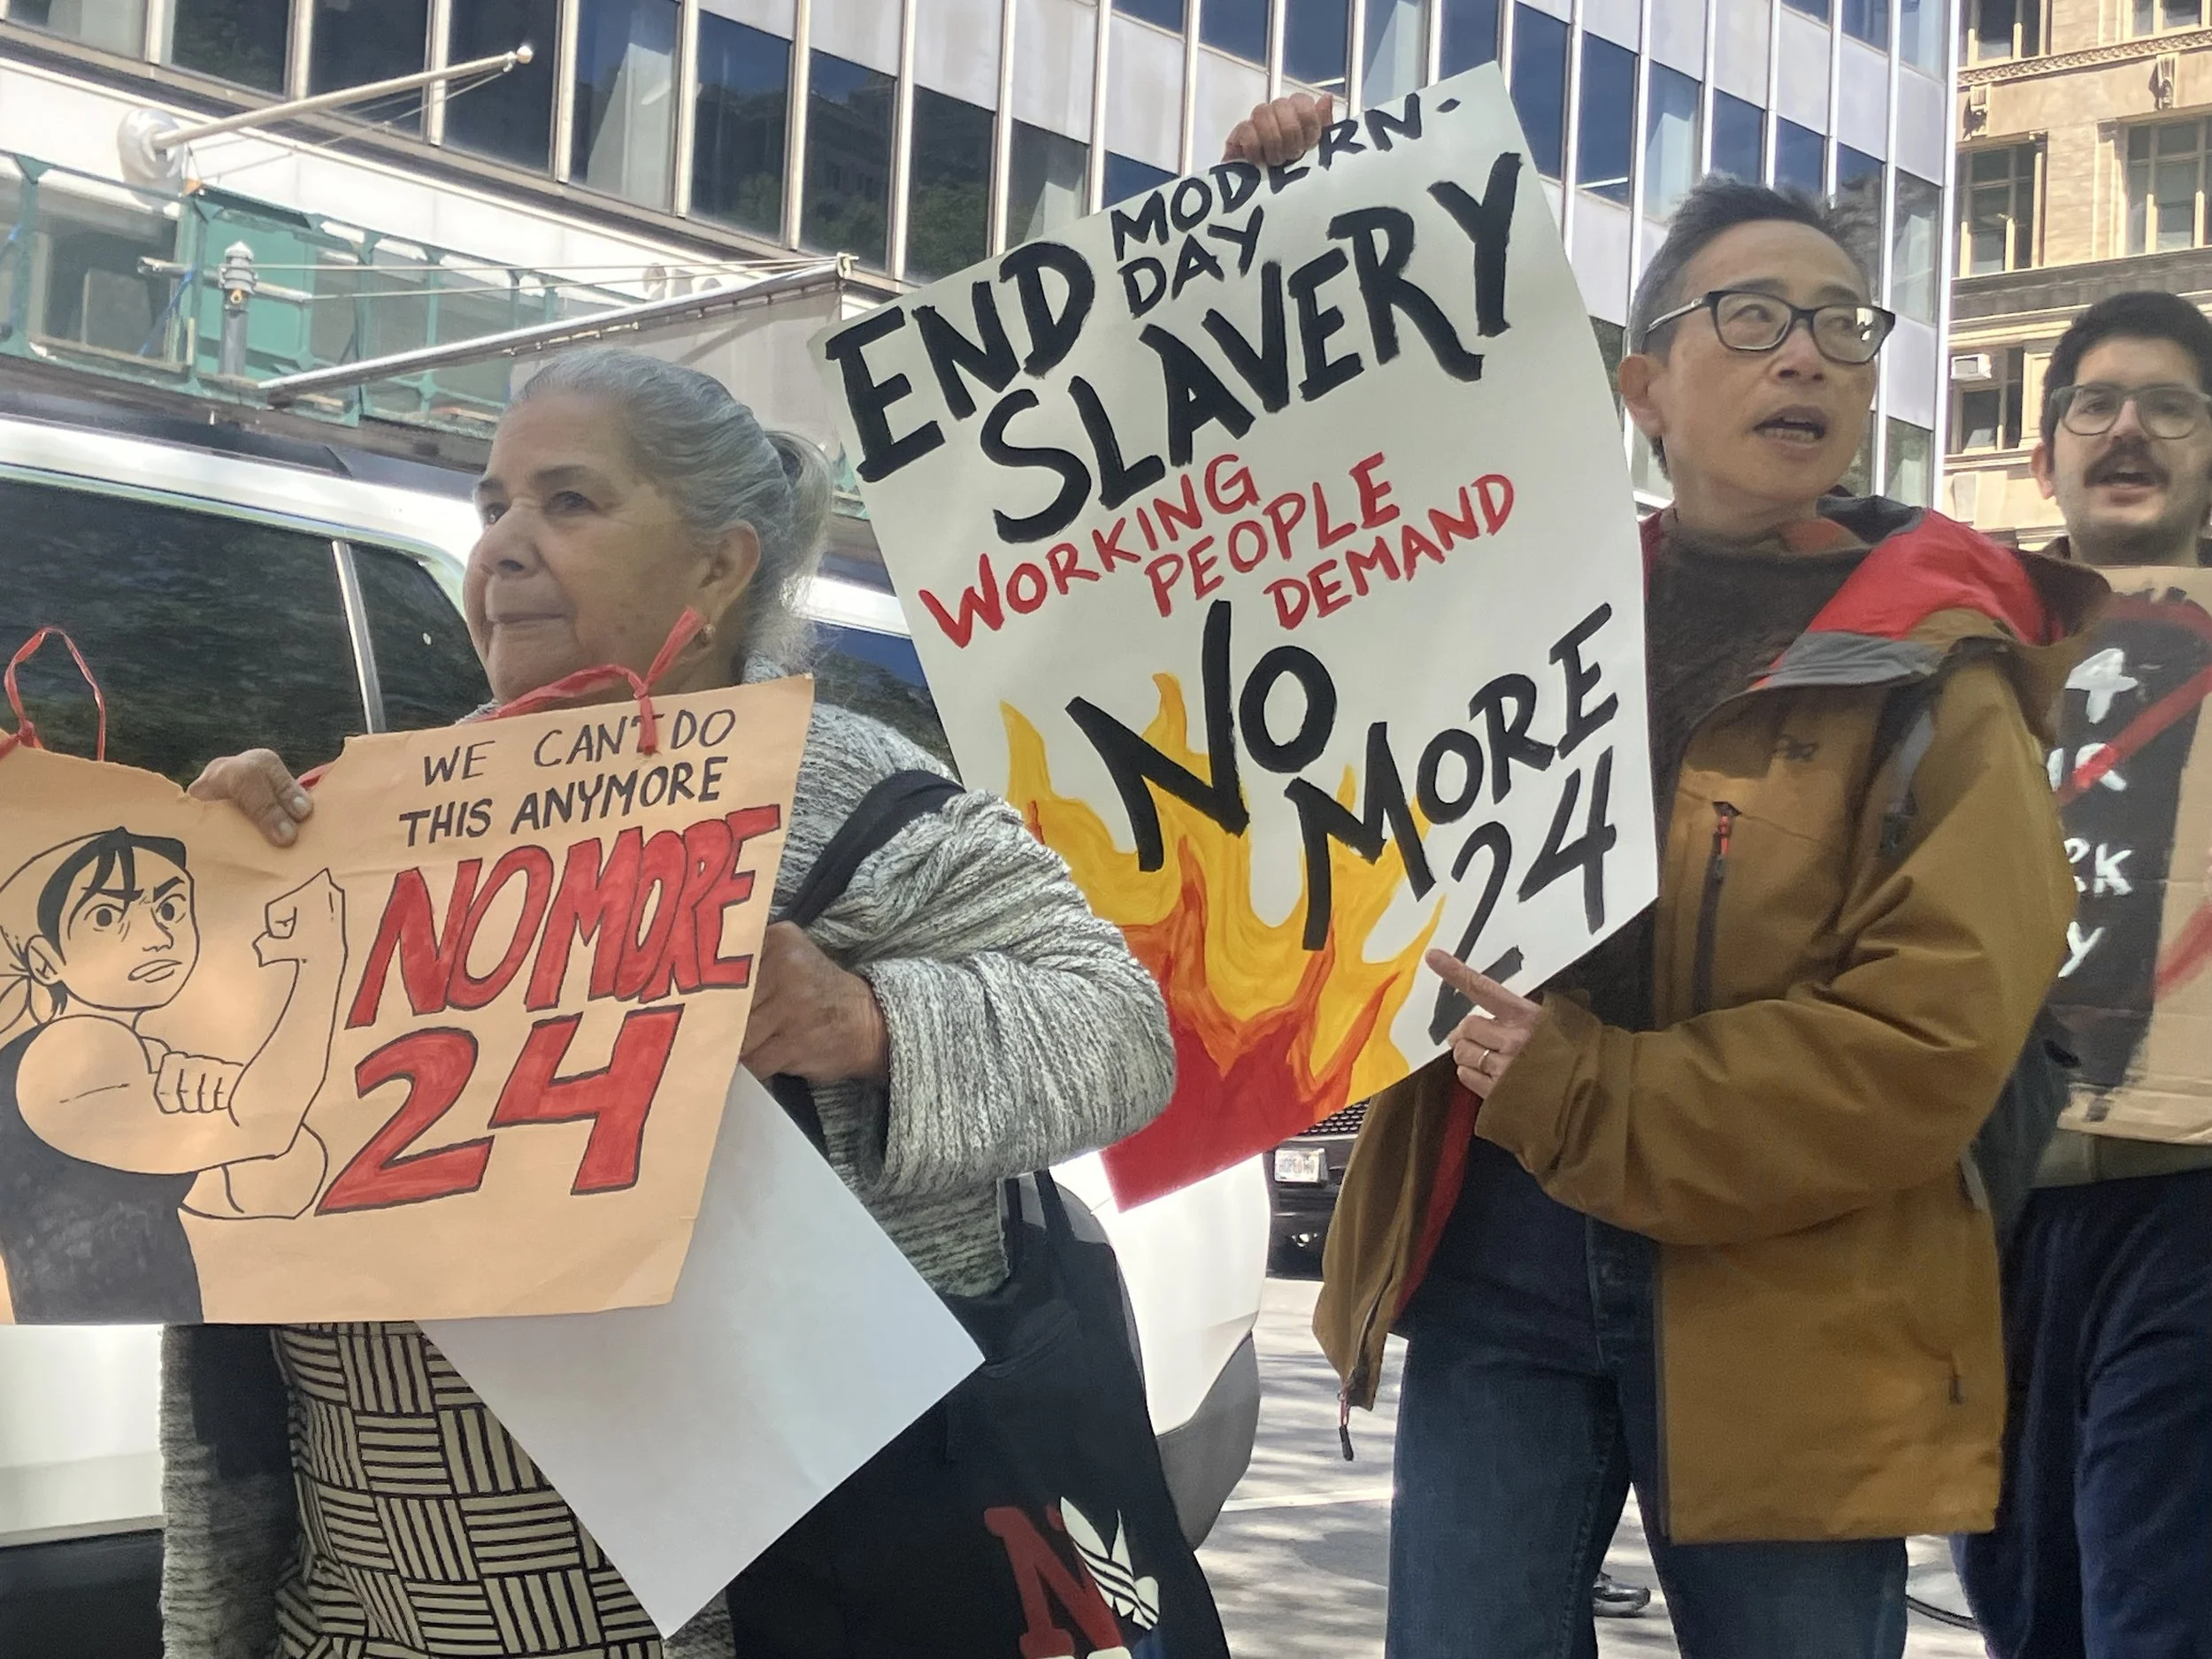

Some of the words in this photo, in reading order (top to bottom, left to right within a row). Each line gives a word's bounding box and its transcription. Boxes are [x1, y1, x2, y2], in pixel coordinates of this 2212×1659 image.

[826, 242, 1095, 483] END
[980, 152, 1522, 543] SLAVERY
[1118, 204, 1264, 319] DAY
[918, 454, 1260, 649] WORKING
[1145, 452, 1401, 618] PEOPLE
[1263, 473, 1516, 630] DEMAND
[399, 798, 494, 848] THIS
[510, 757, 729, 834] ANYMORE
[424, 740, 496, 787] WE
[672, 709, 736, 750] DO
[1064, 599, 1338, 872] NO
[1283, 602, 1621, 951] MORE
[1428, 745, 1617, 1046] 24
[313, 1003, 687, 1217] 24
